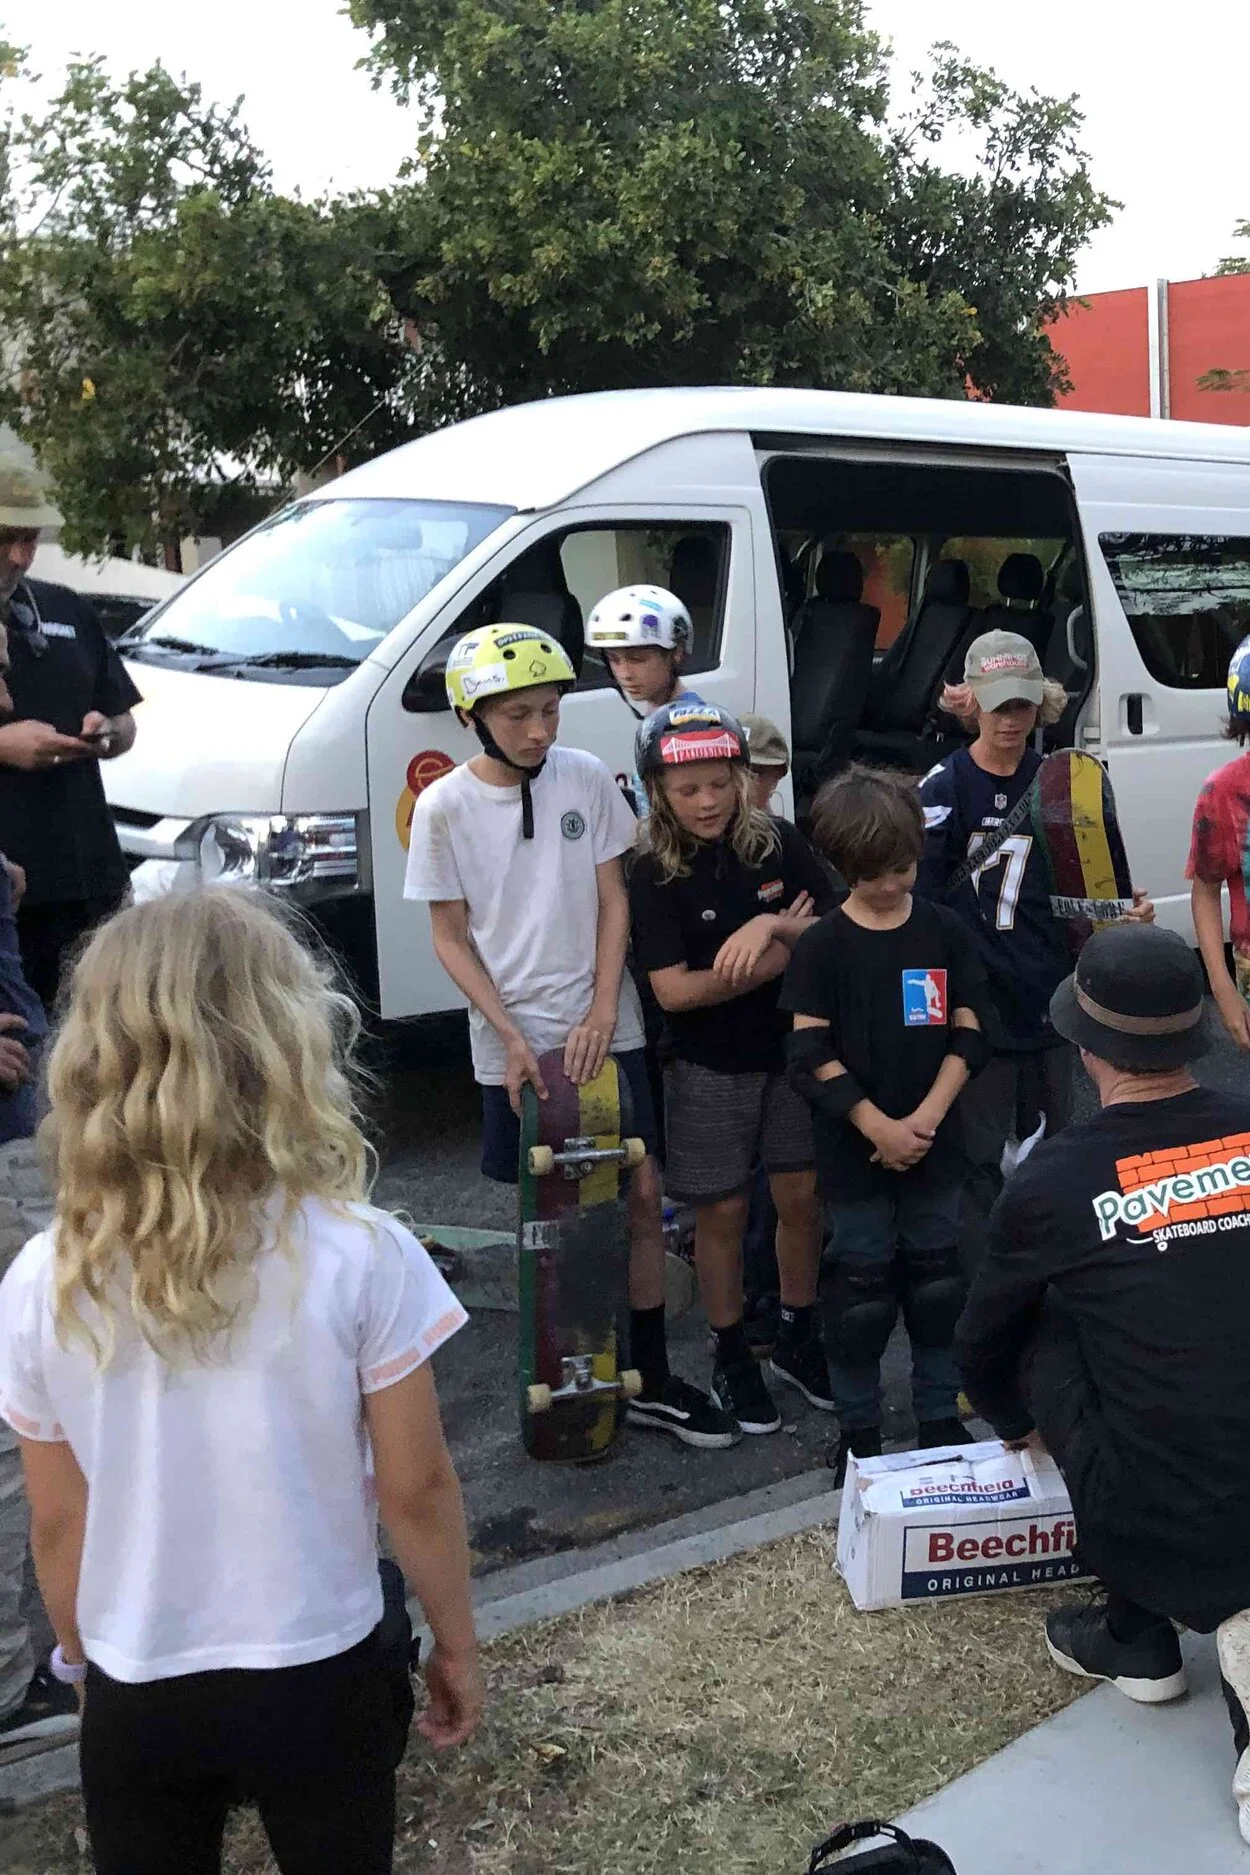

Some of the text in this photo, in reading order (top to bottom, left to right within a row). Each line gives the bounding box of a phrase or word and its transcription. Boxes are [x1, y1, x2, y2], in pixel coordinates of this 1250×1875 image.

[1152, 1218, 1217, 1243] SKATEBOARD
[915, 1494, 963, 1505] ORIGINAL
[928, 1520, 1075, 1563] Beechfi
[927, 1563, 1080, 1592] ORIGINAL HEAD
